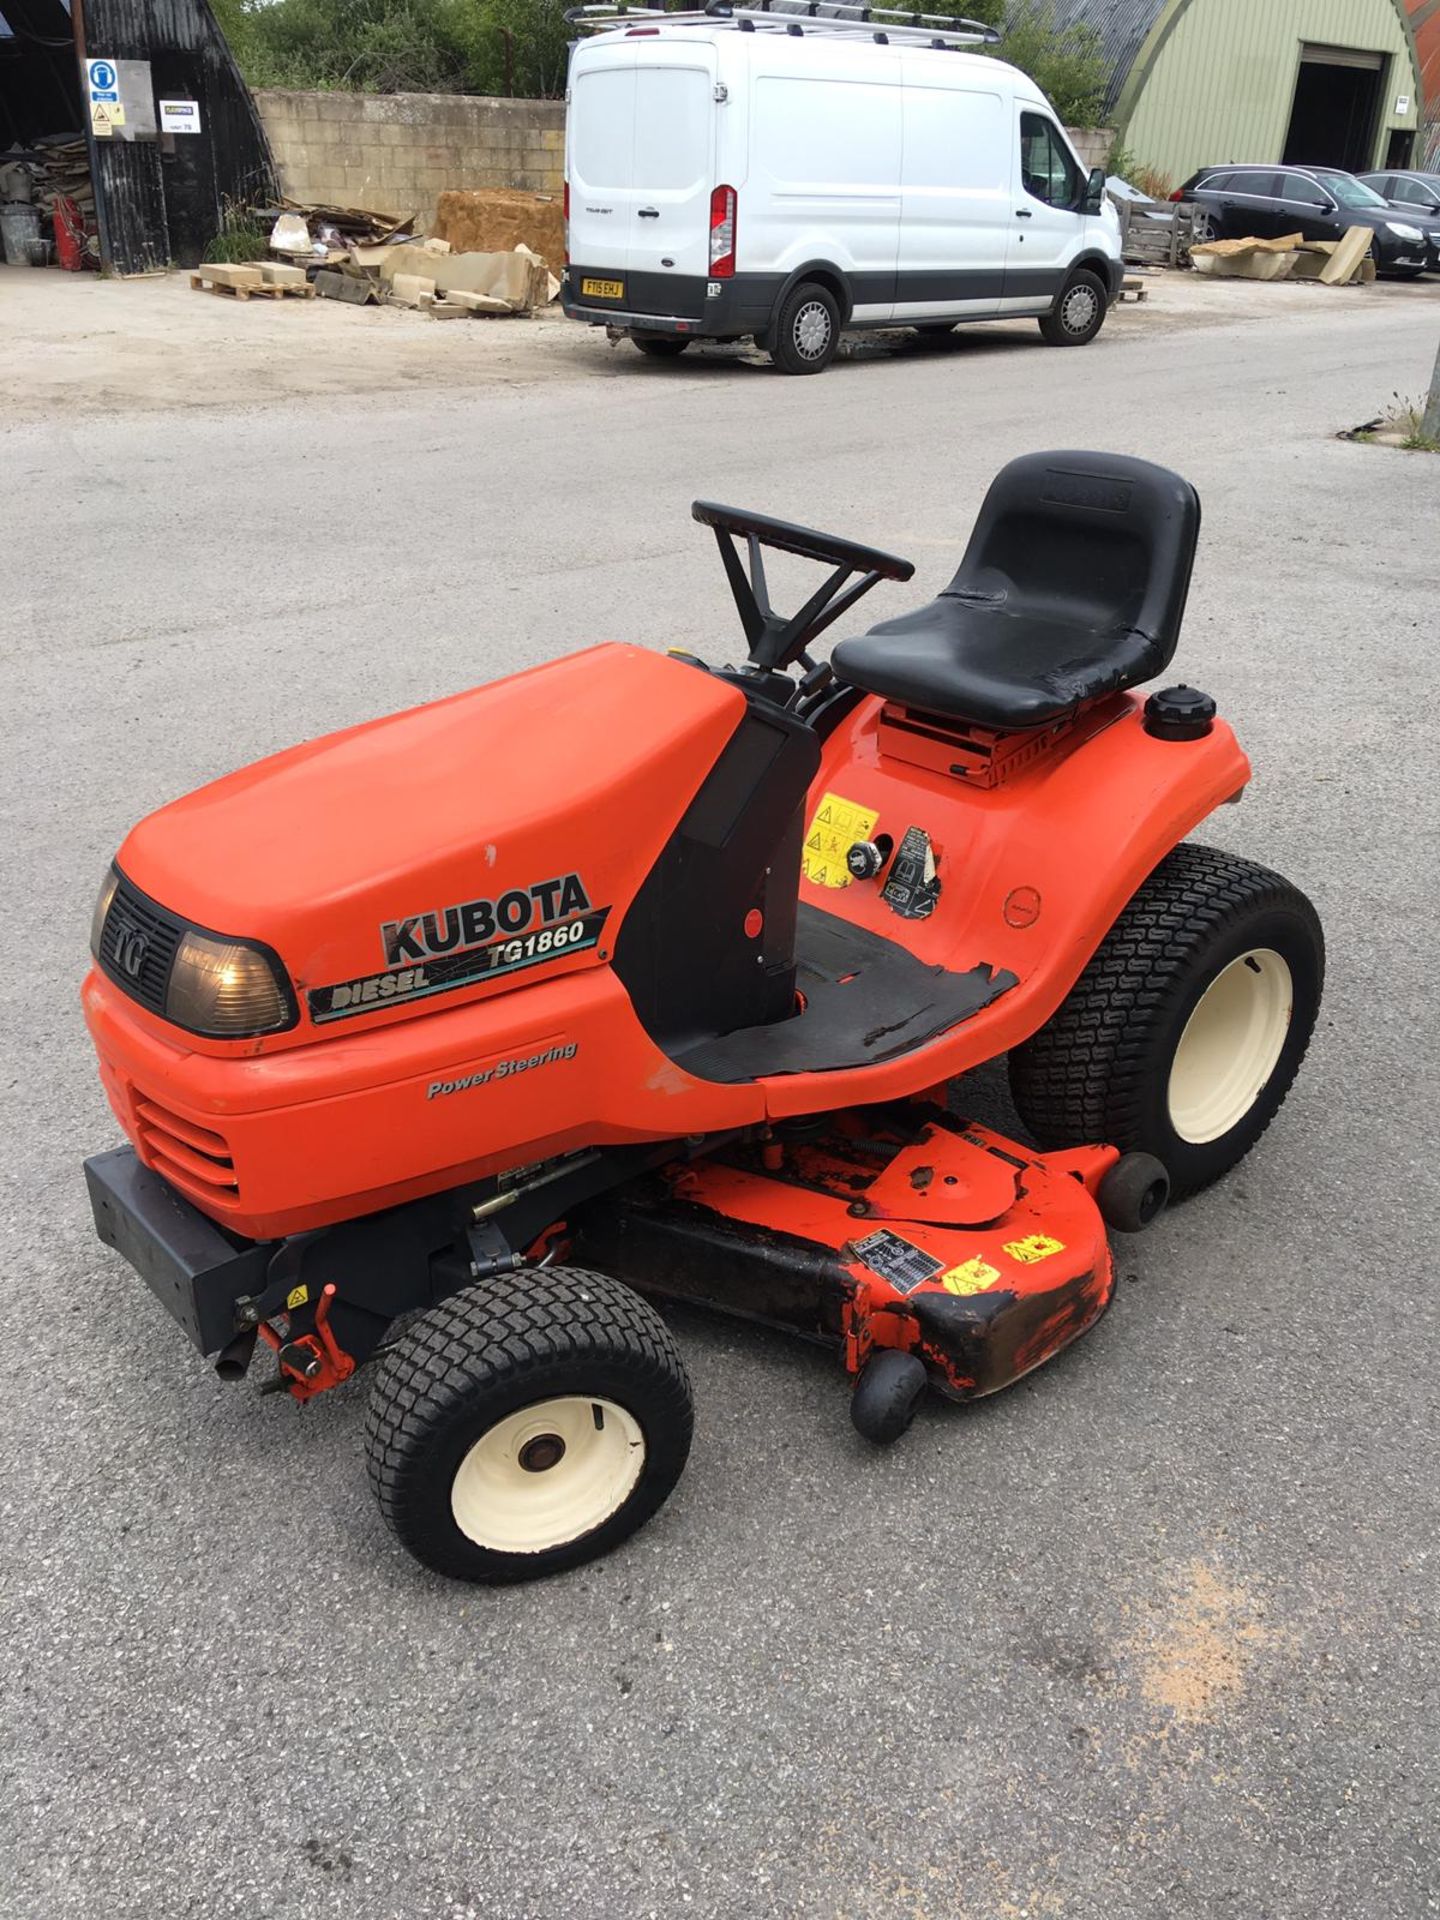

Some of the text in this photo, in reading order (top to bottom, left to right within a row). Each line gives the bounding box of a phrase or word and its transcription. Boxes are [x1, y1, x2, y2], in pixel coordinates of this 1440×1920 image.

[587, 281, 619, 295] FT15 EHJ
[380, 871, 591, 964] KUBOTA
[113, 918, 150, 977] TG
[330, 920, 585, 1010] DIESEL TG1860
[426, 1042, 578, 1100] Power Steering
